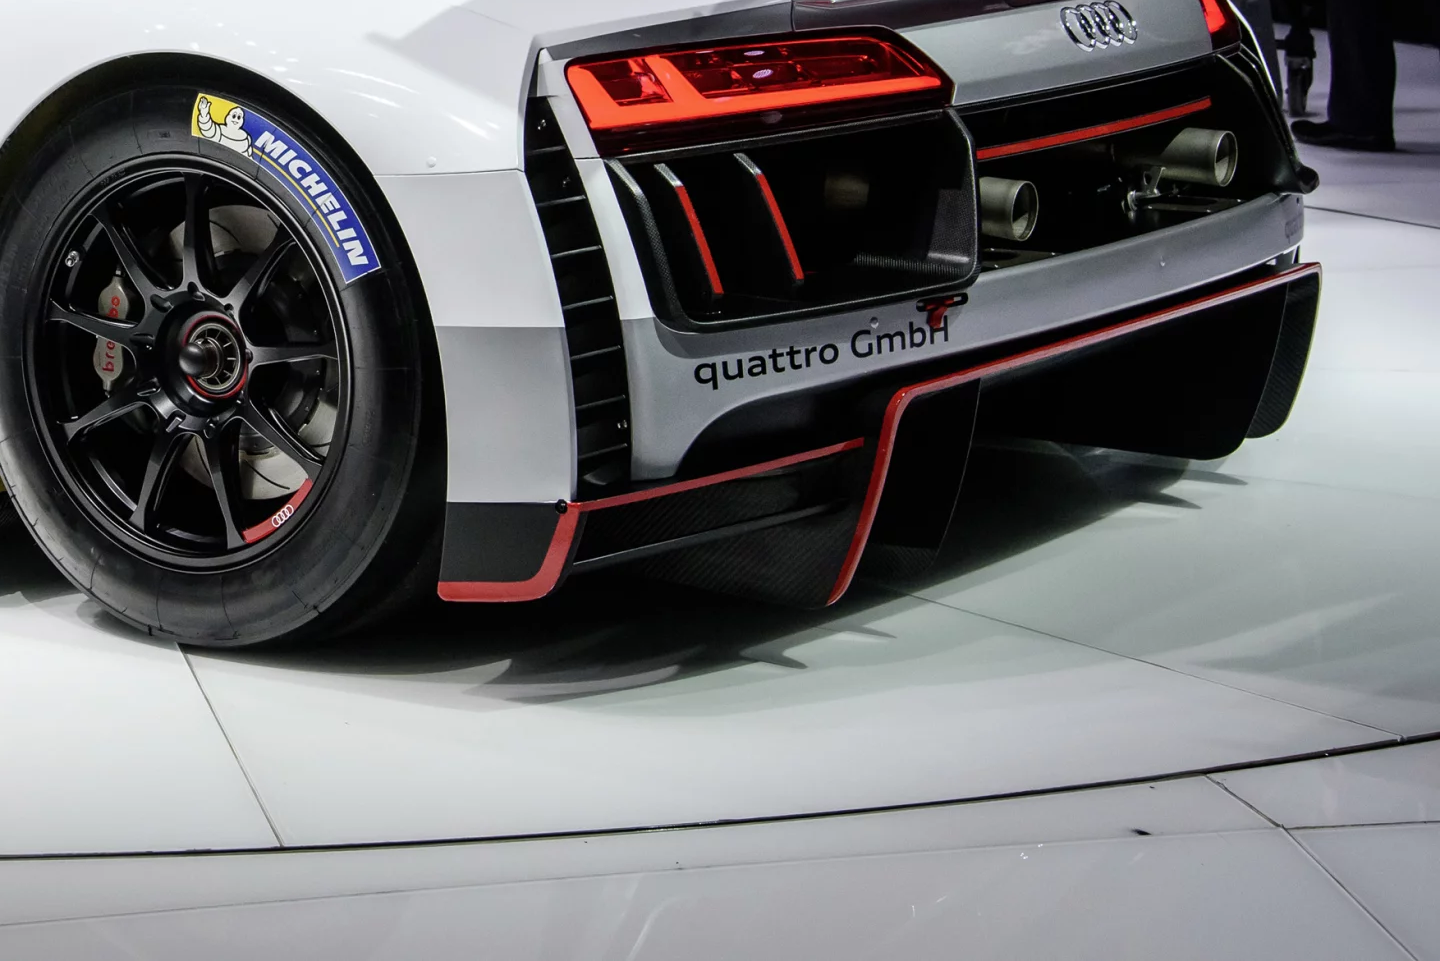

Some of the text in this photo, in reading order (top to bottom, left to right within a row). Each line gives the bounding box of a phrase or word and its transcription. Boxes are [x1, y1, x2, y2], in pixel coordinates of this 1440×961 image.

[254, 130, 369, 266] MICHELIN
[102, 295, 121, 372] brebo
[693, 315, 949, 391] quattro GmbH
